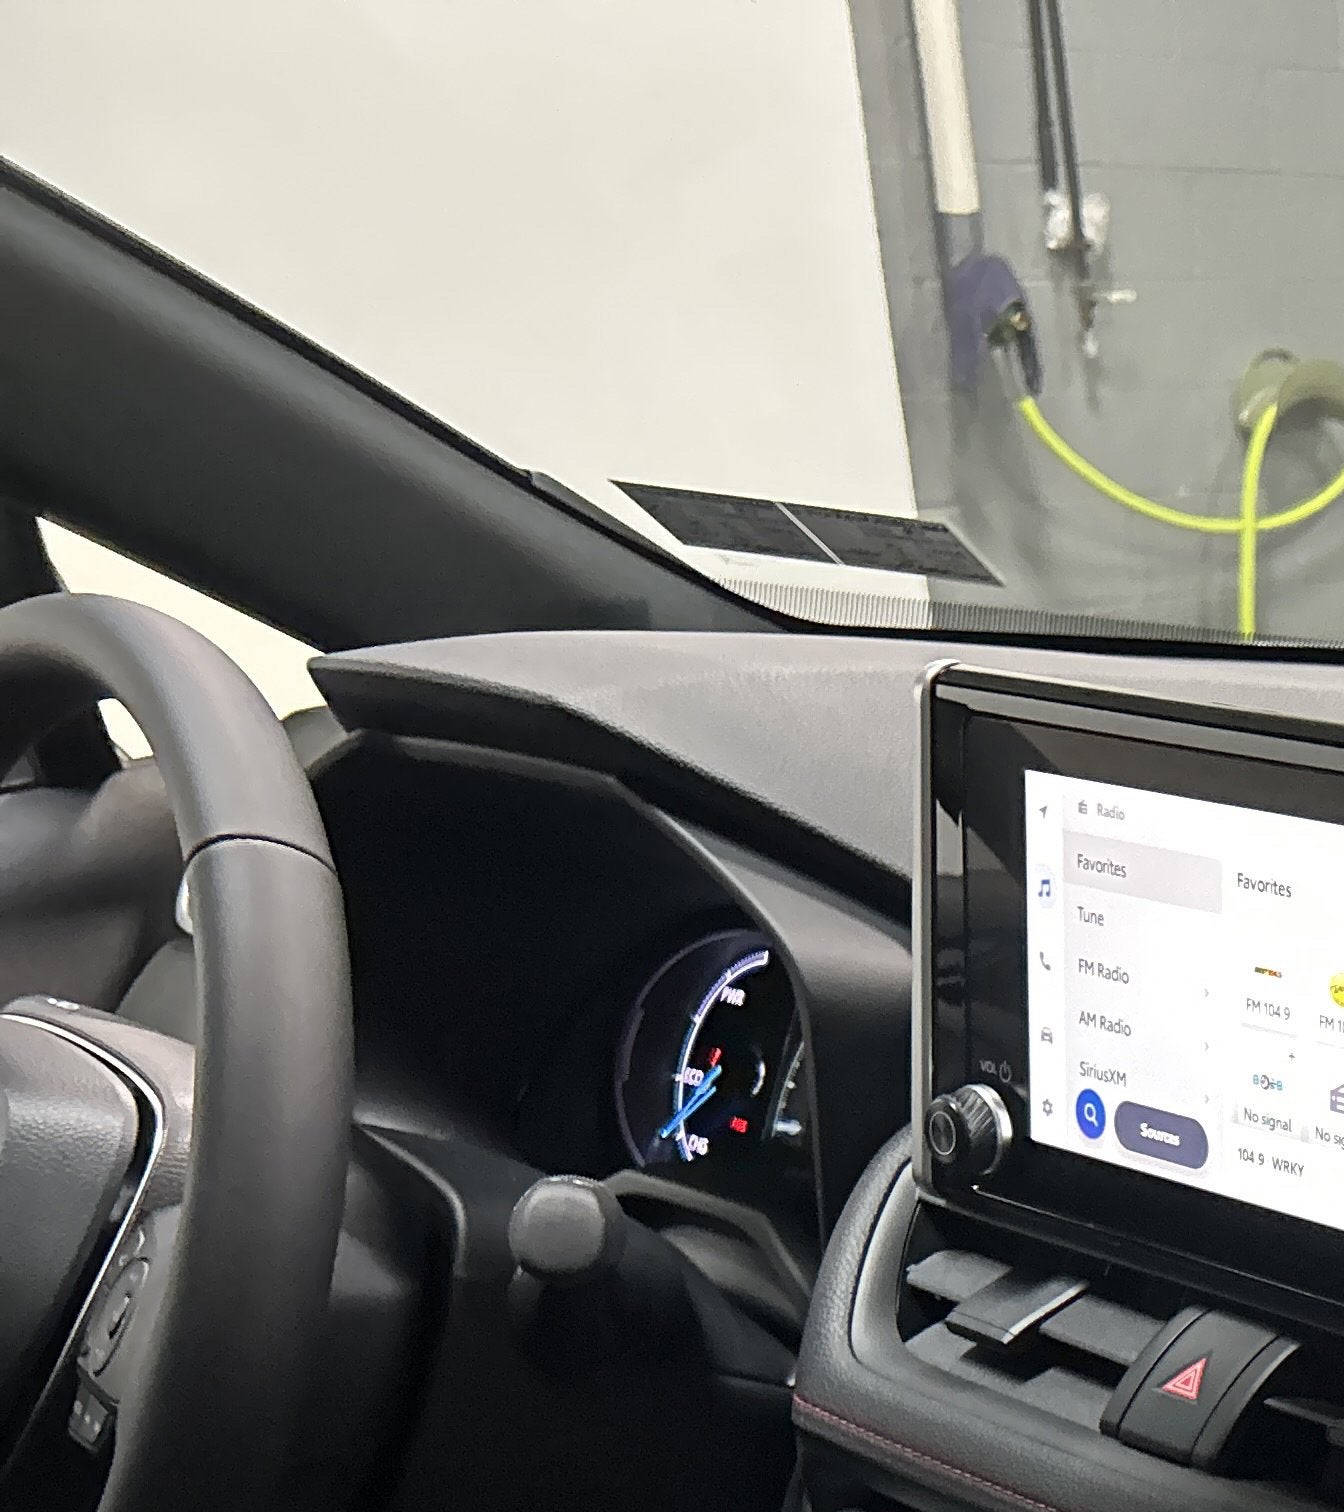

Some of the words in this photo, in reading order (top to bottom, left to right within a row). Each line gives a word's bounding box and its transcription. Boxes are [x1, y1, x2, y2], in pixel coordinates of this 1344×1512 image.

[1096, 802, 1126, 821] Radio
[1076, 853, 1128, 878] Favorites
[1236, 872, 1293, 898] Favorites
[1077, 906, 1105, 927] Tune
[1078, 958, 1095, 976] FM
[1097, 963, 1130, 984] Radio
[1246, 997, 1261, 1013] FM
[1078, 1010, 1097, 1029] AM
[1099, 1016, 1132, 1037] Radio
[1319, 1014, 1335, 1031] FM
[1079, 1060, 1127, 1088] SiriusXM
[1243, 1107, 1259, 1123] No
[1261, 1111, 1292, 1133] signal
[1315, 1126, 1331, 1142] No
[1271, 1155, 1305, 1177] WRKY
